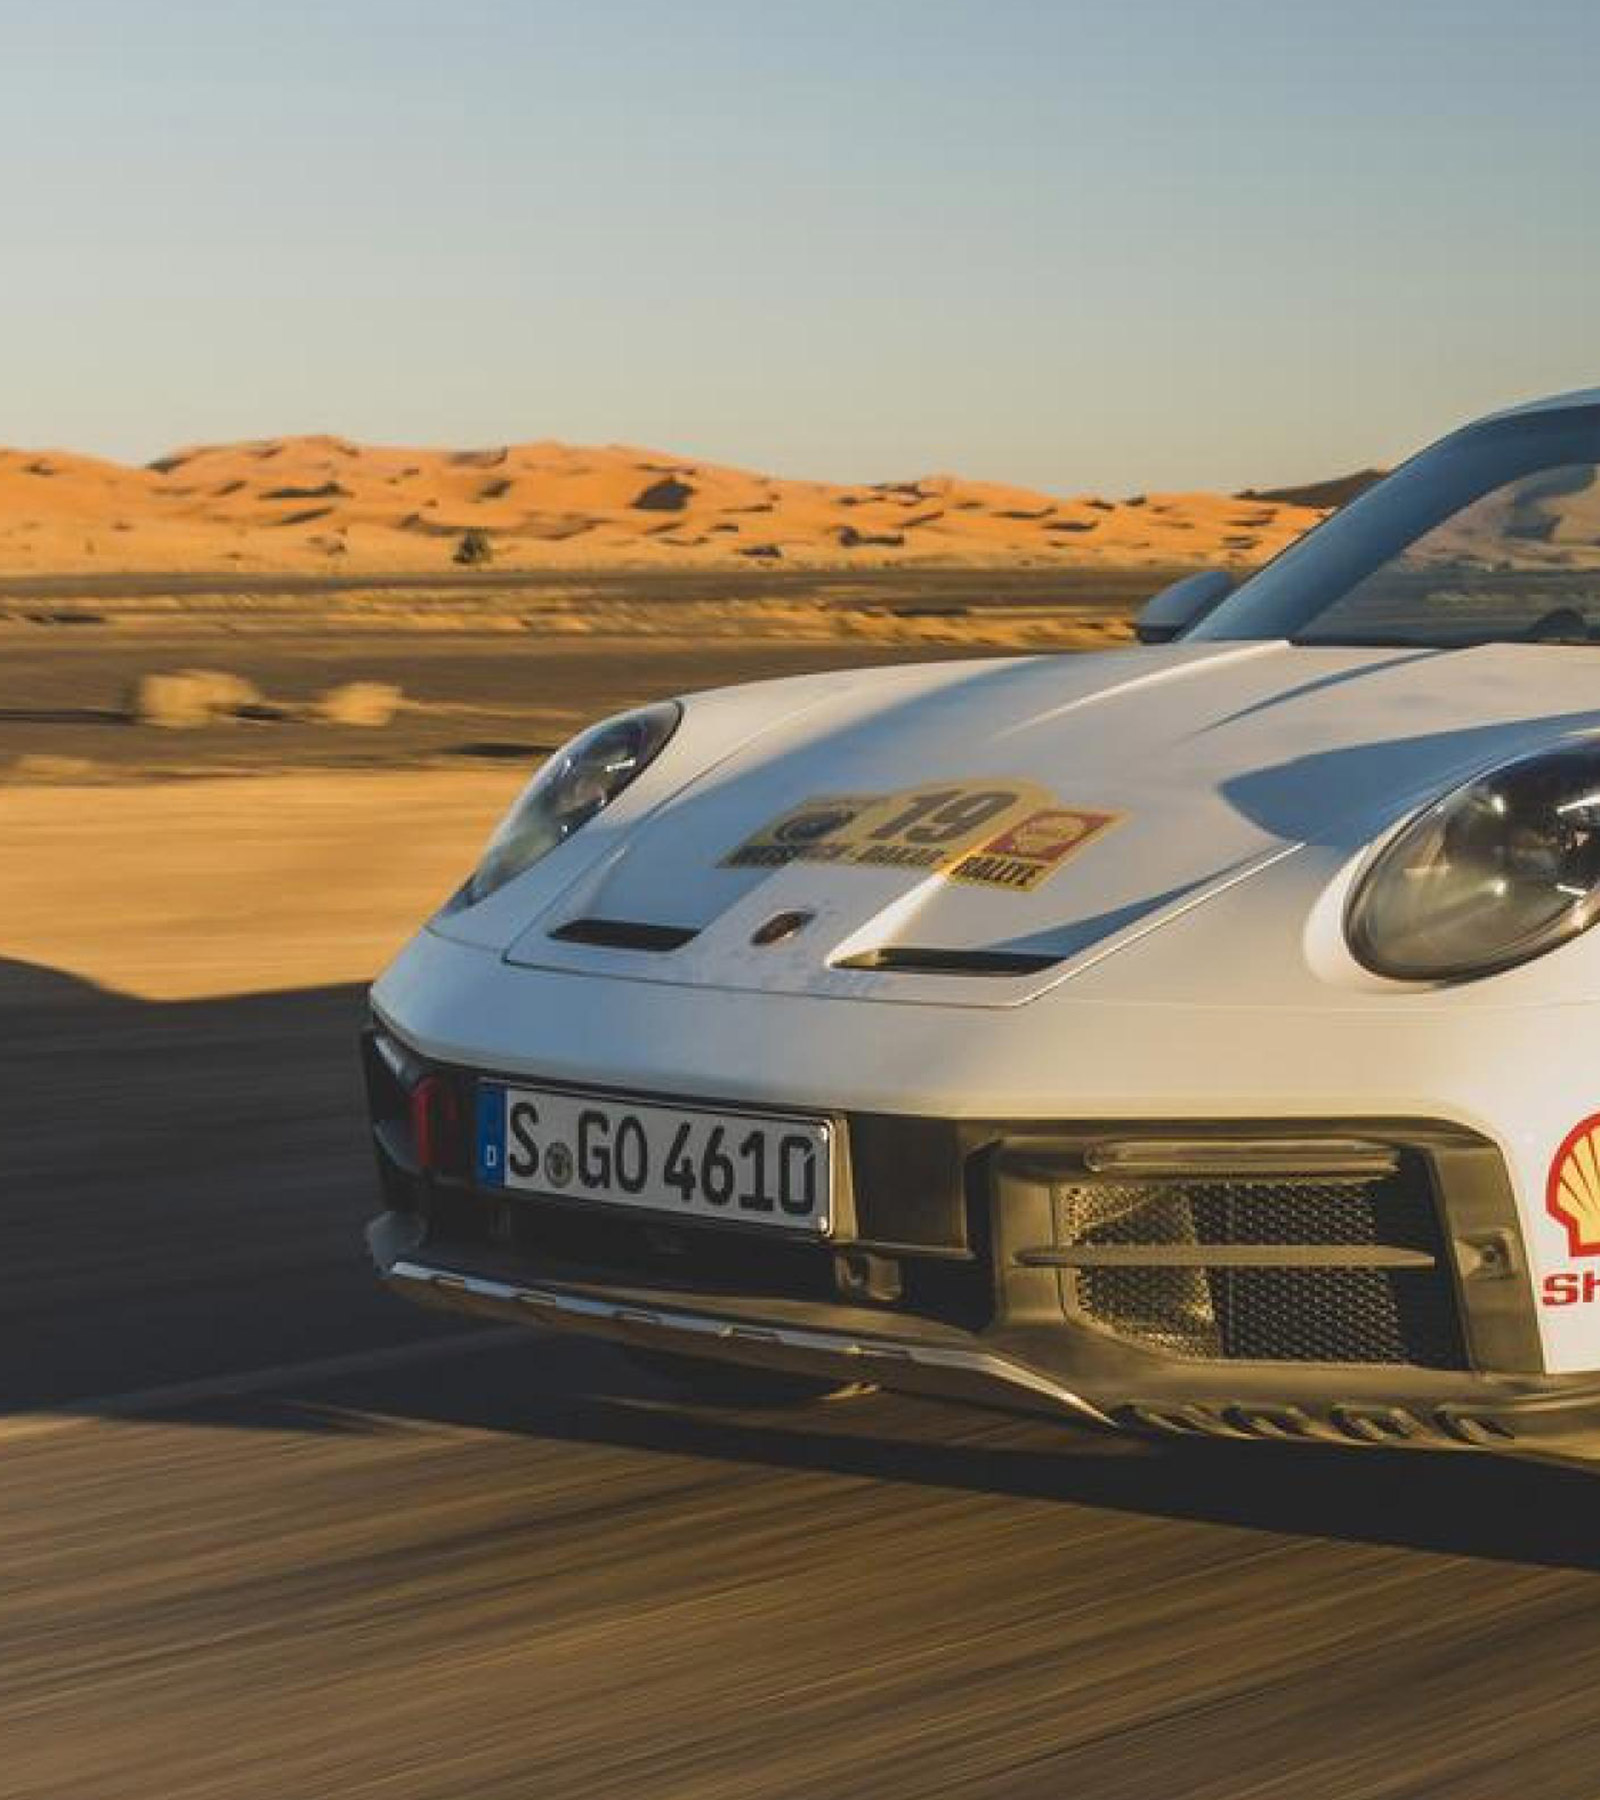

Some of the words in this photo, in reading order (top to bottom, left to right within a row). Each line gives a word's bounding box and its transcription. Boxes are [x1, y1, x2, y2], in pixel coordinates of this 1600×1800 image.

[868, 790, 1018, 843] 19
[509, 1101, 539, 1177] S
[577, 1110, 648, 1193] GO
[663, 1121, 816, 1215] 4610
